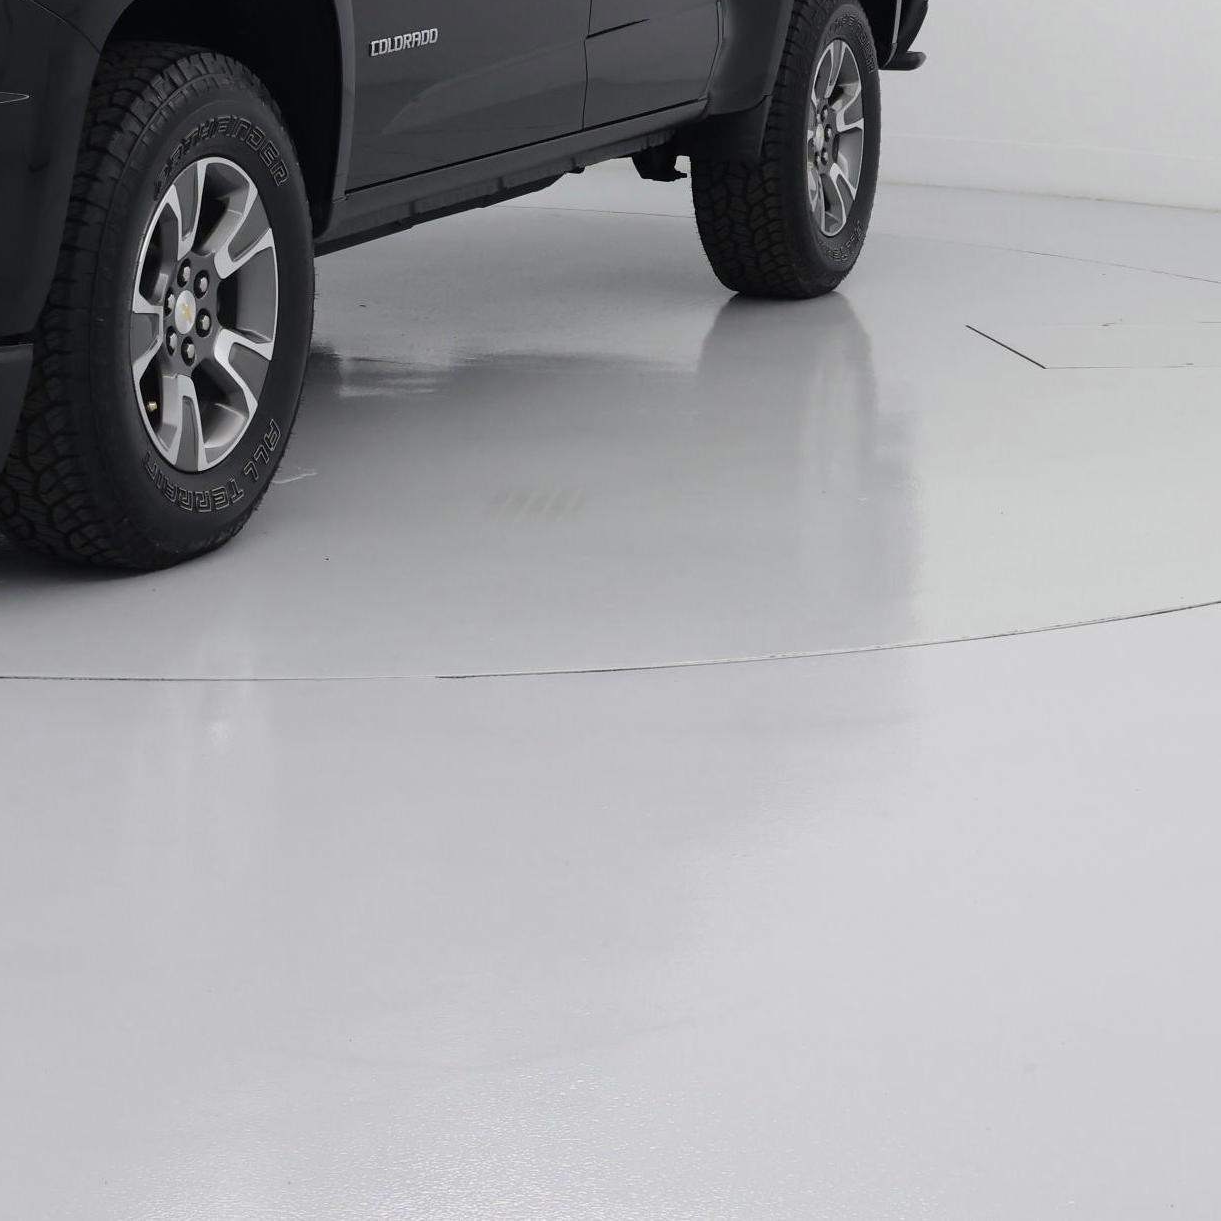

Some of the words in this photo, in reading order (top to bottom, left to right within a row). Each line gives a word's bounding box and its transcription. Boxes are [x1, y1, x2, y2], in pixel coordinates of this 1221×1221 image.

[370, 27, 438, 57] COLORADO
[243, 418, 282, 482] ALL
[142, 452, 245, 513] TERRAIN
